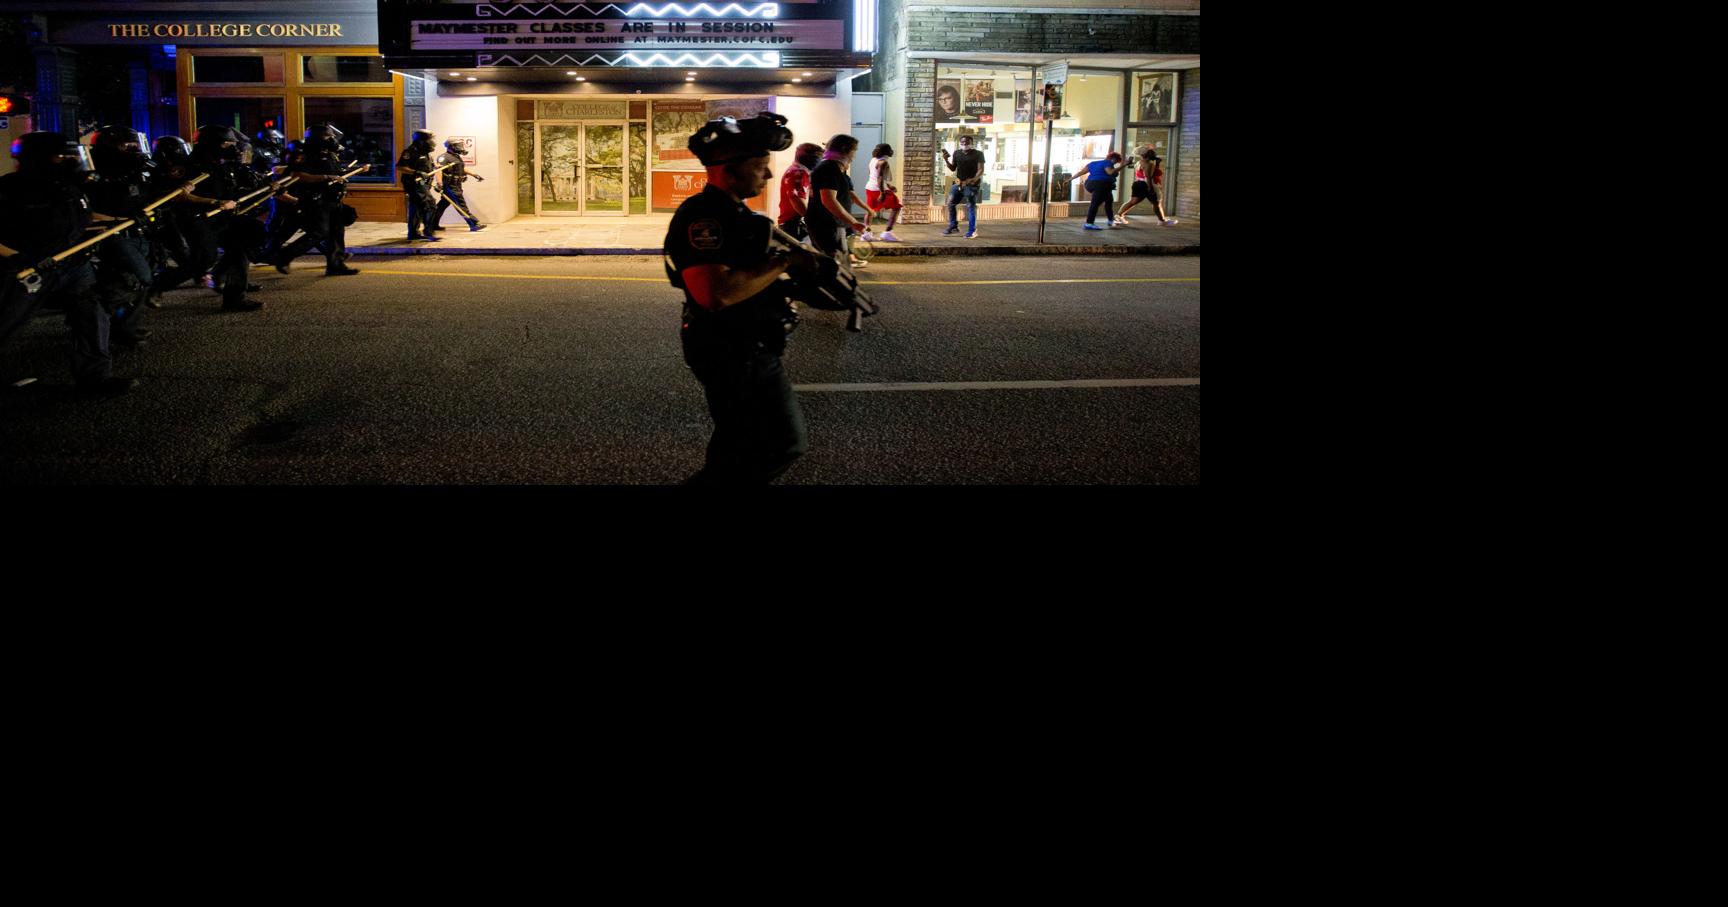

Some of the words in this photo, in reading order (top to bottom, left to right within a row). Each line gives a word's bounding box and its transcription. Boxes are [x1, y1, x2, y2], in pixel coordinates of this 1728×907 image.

[108, 23, 149, 37] THE
[153, 23, 252, 37] COLLEGE
[256, 23, 343, 37] CORNER
[418, 23, 517, 34] MAYMESTER
[530, 23, 605, 33] CLASSES
[621, 22, 653, 33] ARE
[668, 22, 686, 32] IN
[702, 22, 774, 33] SESSION
[483, 36, 508, 44] FIND
[515, 36, 536, 44] OUT
[544, 36, 576, 44] MORE
